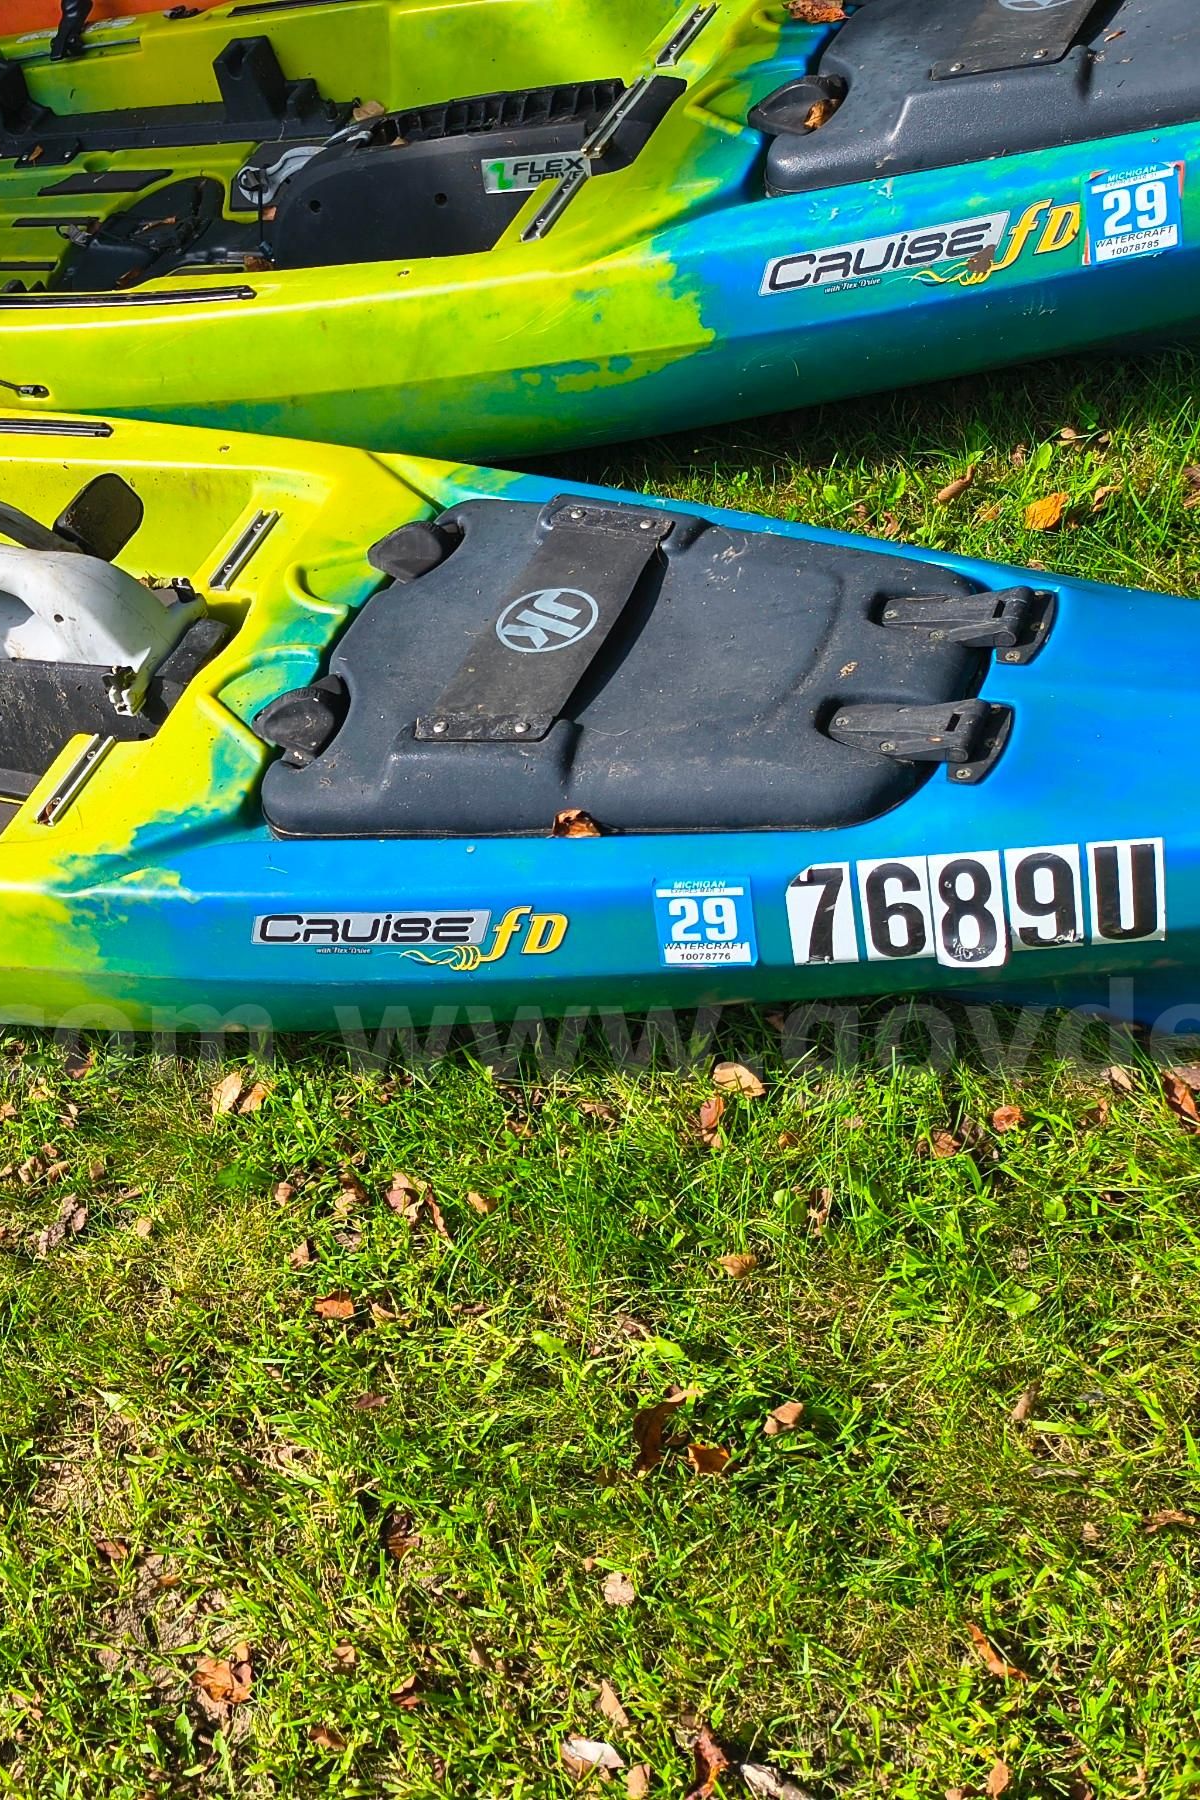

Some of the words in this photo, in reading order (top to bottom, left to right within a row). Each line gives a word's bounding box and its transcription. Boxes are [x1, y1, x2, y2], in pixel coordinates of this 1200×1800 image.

[513, 157, 584, 175] FLEX
[1107, 165, 1157, 183] MICHIGAN
[1103, 181, 1167, 236] 29
[1095, 225, 1174, 248] WATERCRAFT
[1111, 240, 1159, 255] 10078785
[673, 881, 726, 889] MICHIGAN
[791, 844, 1159, 964] 7689U
[668, 898, 738, 942] 29
[664, 942, 745, 951] WATERCRAFT
[680, 952, 732, 961] 10078776
